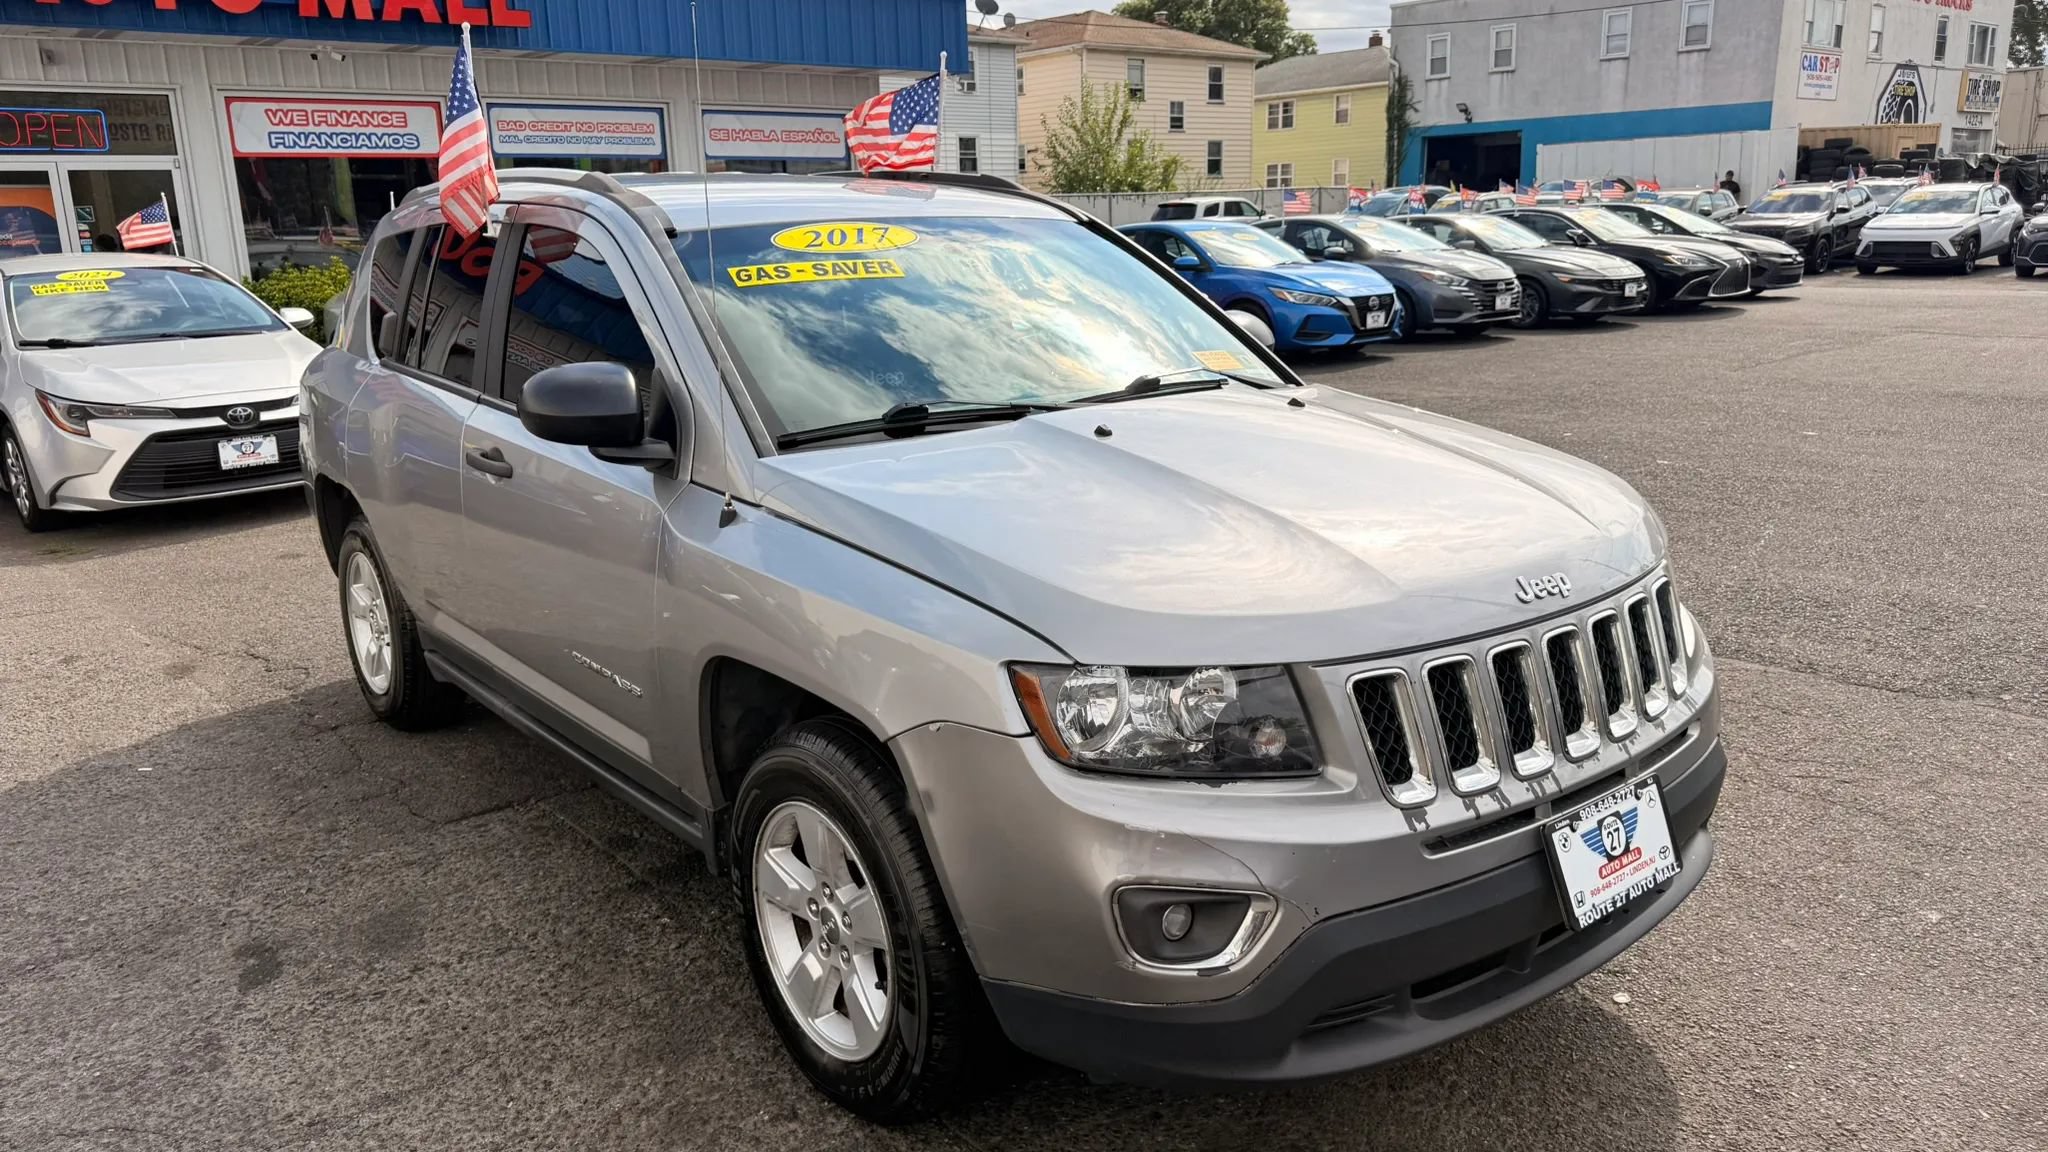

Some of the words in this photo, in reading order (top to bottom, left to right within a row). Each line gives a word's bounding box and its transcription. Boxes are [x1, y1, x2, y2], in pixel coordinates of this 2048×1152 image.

[1801, 54, 1819, 72] CAR
[1967, 78, 1981, 95] TIRE
[1982, 79, 2001, 96] SHOP
[265, 109, 307, 126] WE
[312, 109, 407, 128] FINANCE
[497, 121, 527, 132] BAD
[530, 121, 574, 133] CREDIT
[576, 122, 595, 133] NO
[597, 122, 655, 134] PROBLEM
[0, 112, 104, 148] OPEN
[268, 132, 419, 149] FINANCIAMOS
[499, 135, 522, 143] MAL
[524, 135, 565, 144] CREDITO
[567, 136, 582, 144] NO
[584, 136, 603, 145] HAY
[605, 136, 655, 146] PROBLEMA
[709, 128, 730, 141] SE
[731, 129, 779, 142] HABLA
[781, 128, 840, 144] ESPAÑOL
[804, 226, 890, 248] 2017
[735, 265, 791, 283] GAS
[812, 260, 897, 276] SAVER
[1515, 571, 1572, 604] Jeep
[571, 651, 643, 698] COMPASS
[1580, 785, 1635, 820] 908-648-2727
[1554, 820, 1570, 830] Linden
[1603, 819, 1619, 831] ROUTE
[1606, 827, 1621, 852] 27
[1601, 860, 1620, 879] AUTO
[1621, 850, 1640, 866] MALL
[1578, 901, 1614, 929] ROUTE
[1614, 891, 1627, 908] 27
[1627, 876, 1654, 900] AUTO
[1655, 861, 1681, 884] MALL
[1590, 872, 1626, 898] 908-648-2727
